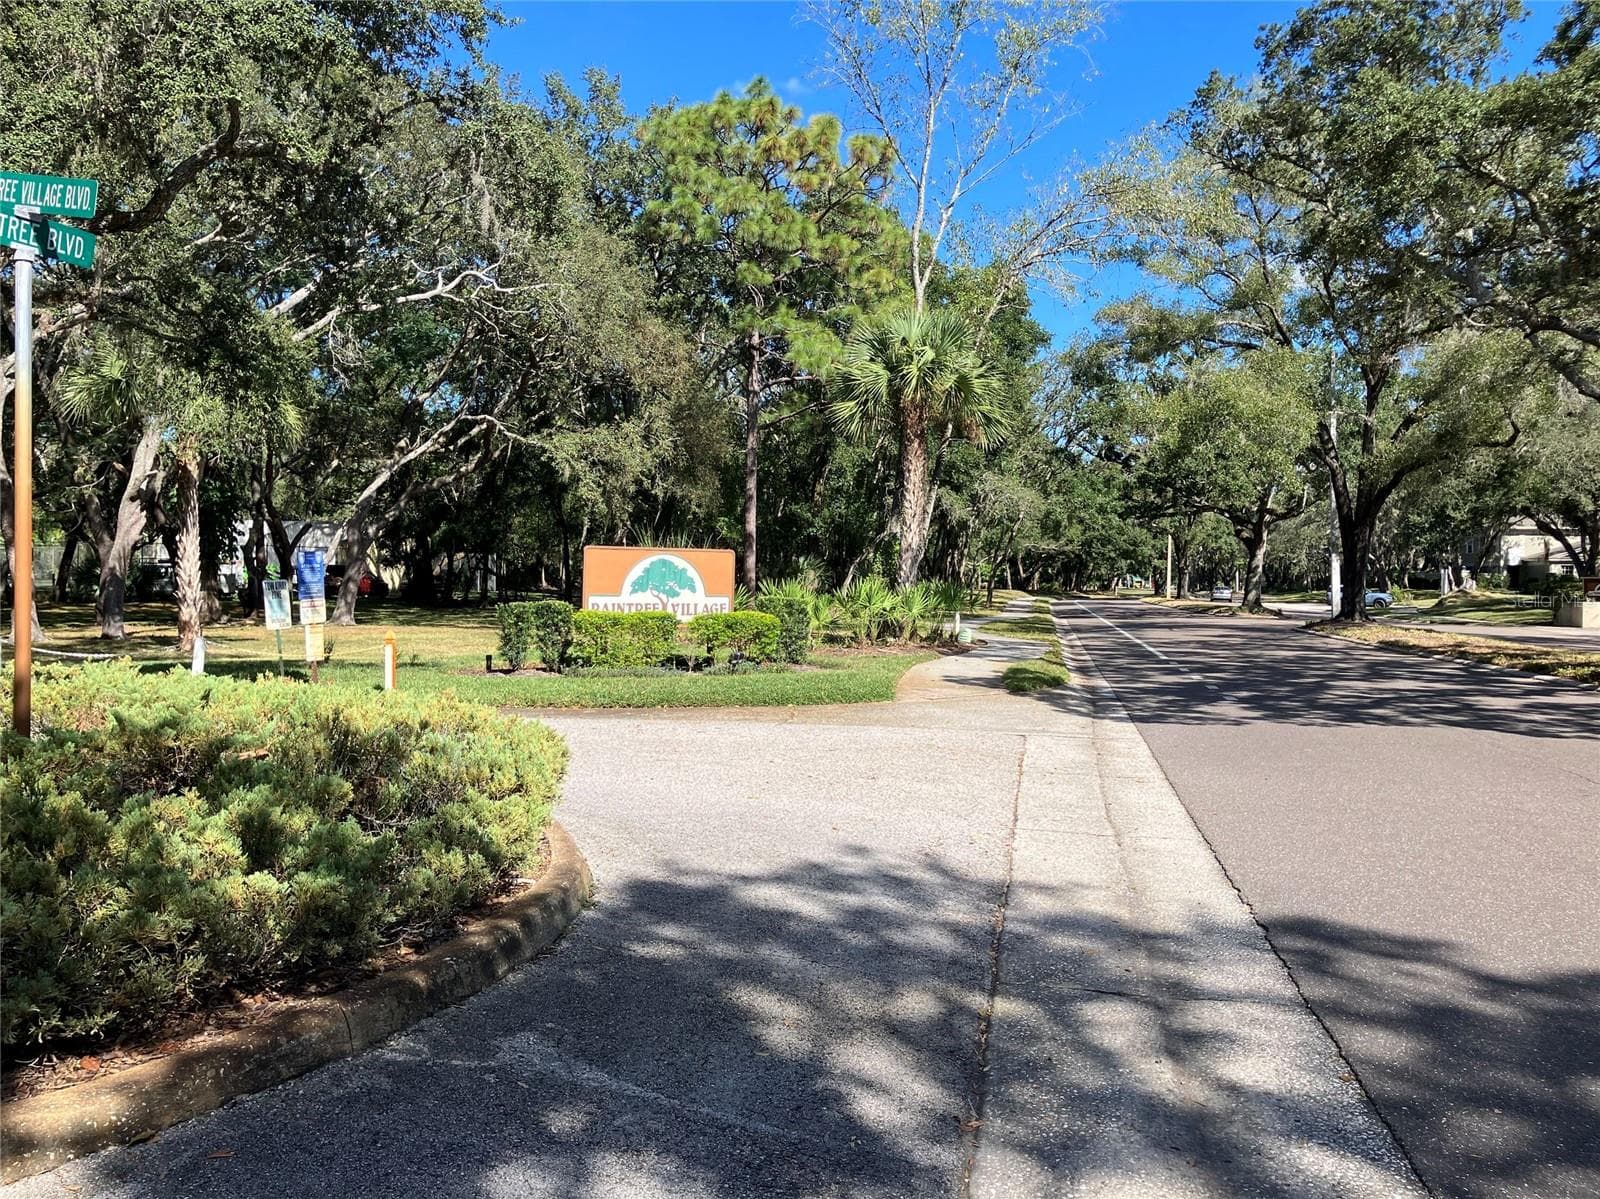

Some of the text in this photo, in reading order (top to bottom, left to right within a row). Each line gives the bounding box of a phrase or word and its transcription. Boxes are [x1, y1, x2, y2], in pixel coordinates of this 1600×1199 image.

[21, 181, 63, 207] VILLAGE
[65, 185, 91, 211] BLVD.
[47, 227, 85, 260] BLVD.
[671, 602, 727, 616] VILLAGE
